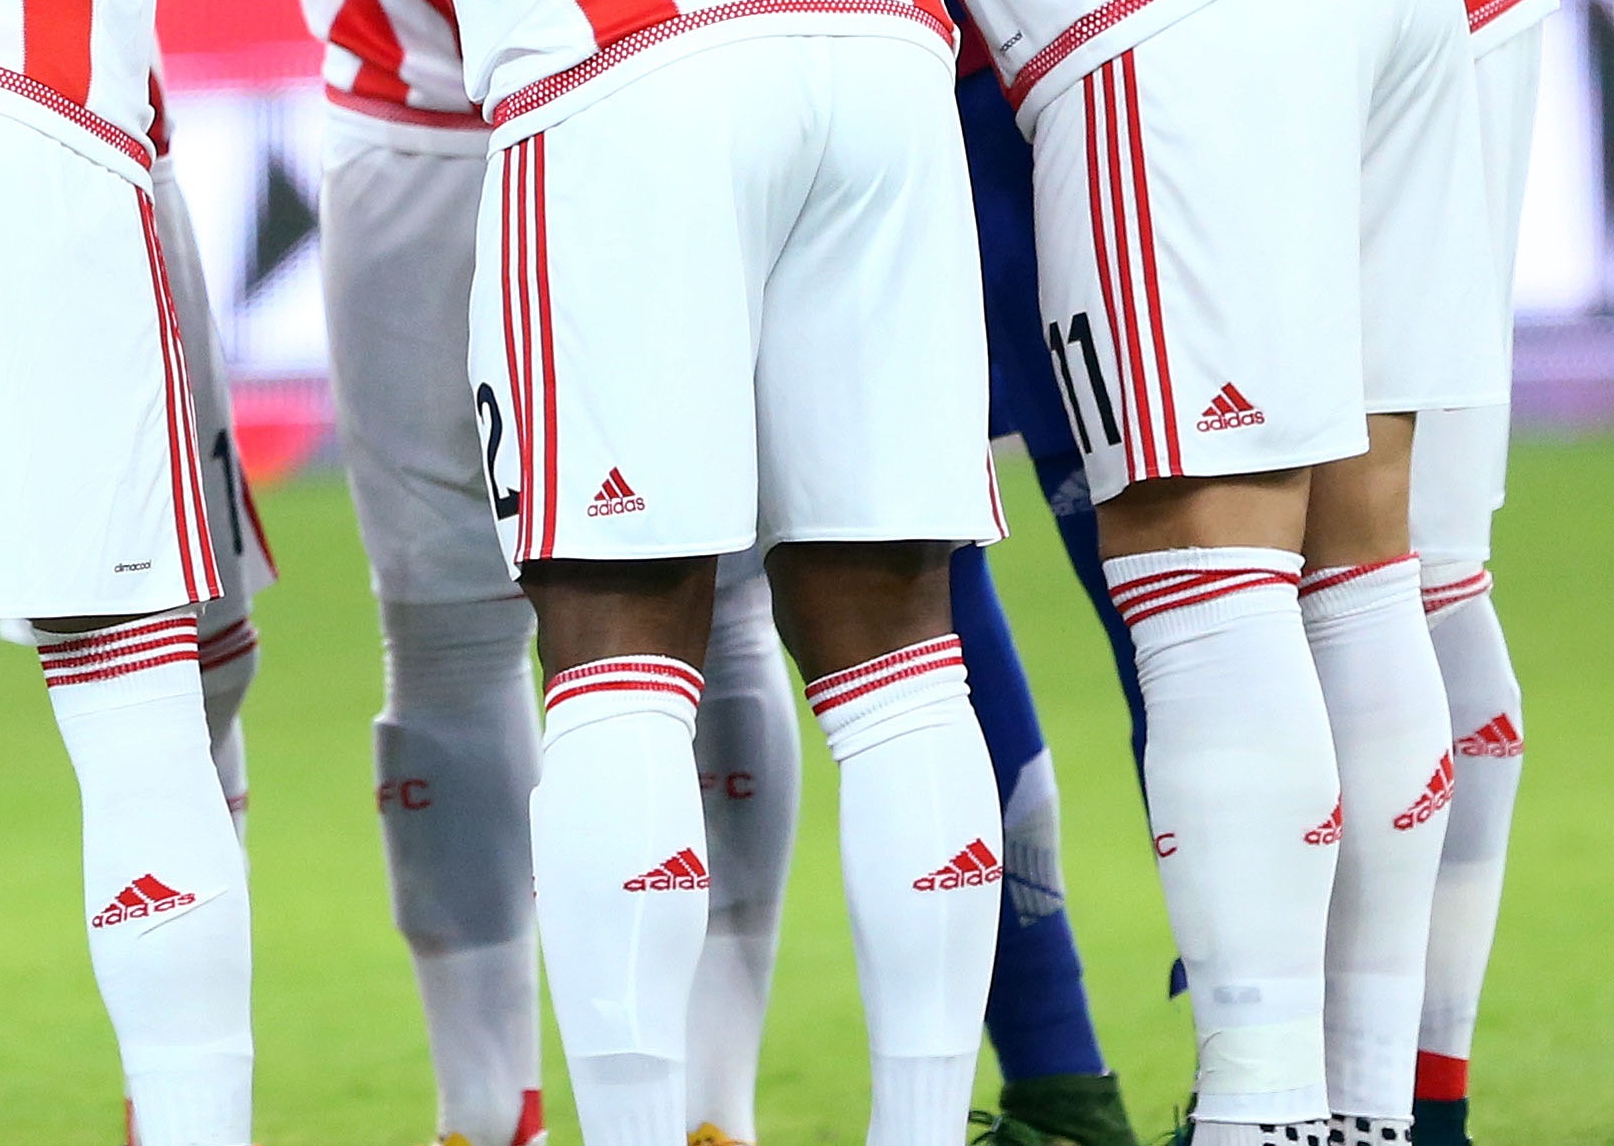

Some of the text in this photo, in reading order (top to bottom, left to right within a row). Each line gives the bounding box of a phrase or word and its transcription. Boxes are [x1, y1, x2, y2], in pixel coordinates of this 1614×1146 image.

[1049, 311, 1123, 455] 11
[1196, 410, 1265, 433] adidas
[586, 496, 646, 517] adidas
[91, 892, 196, 929] adidas
